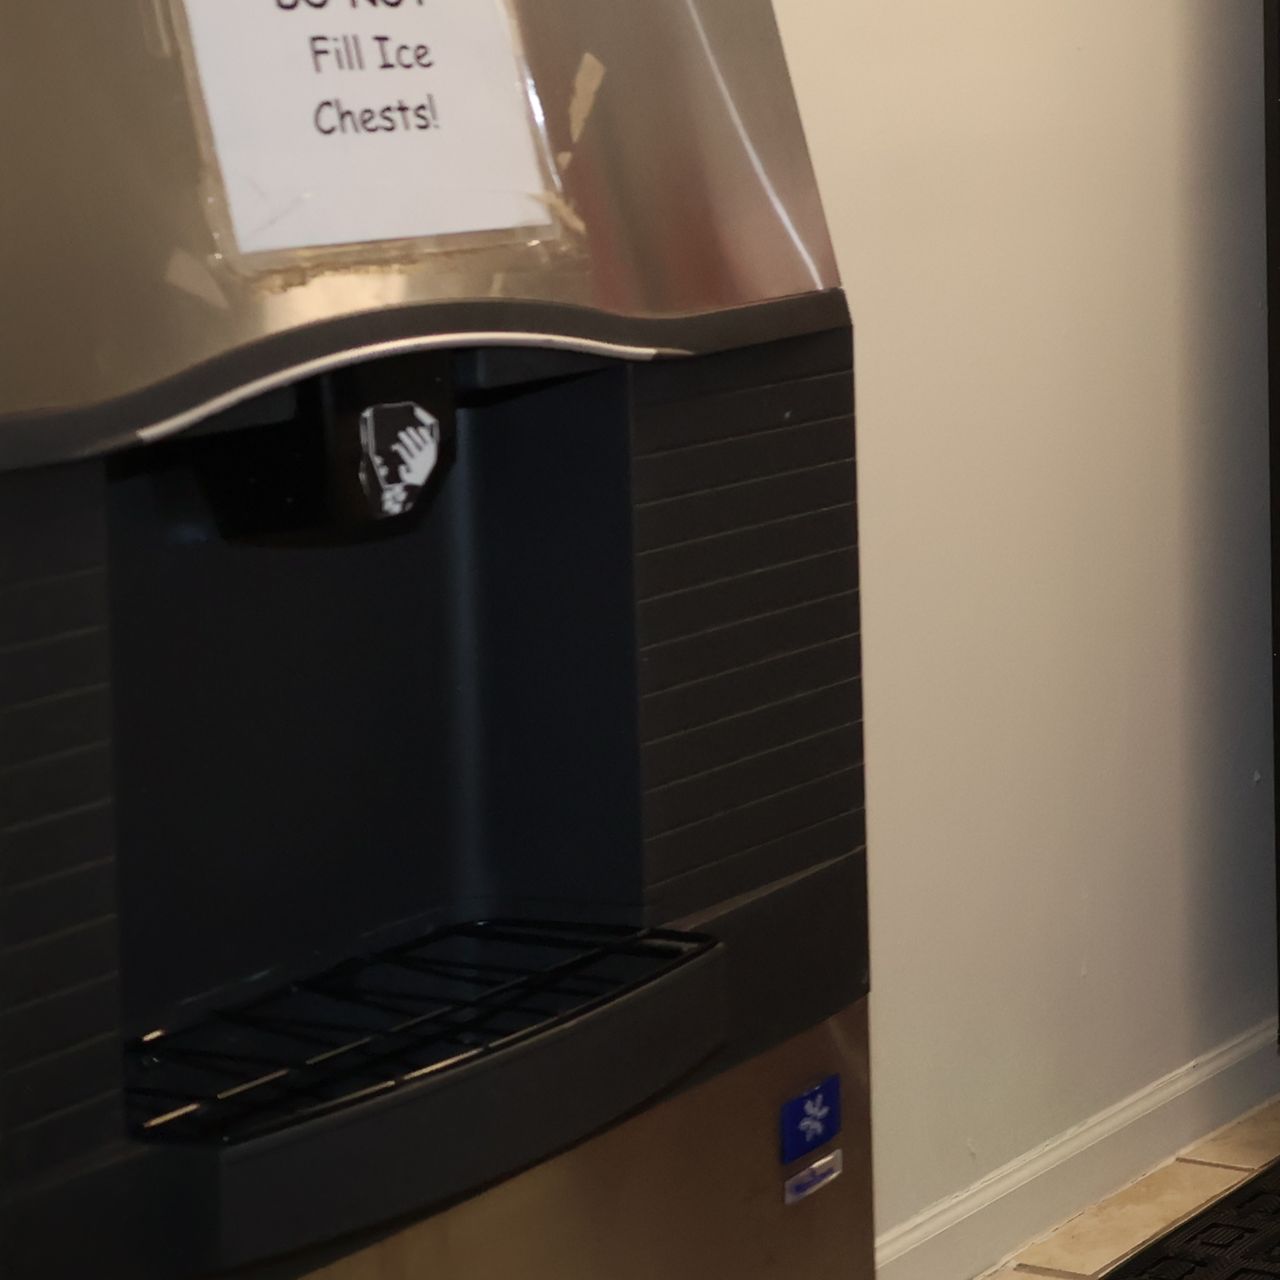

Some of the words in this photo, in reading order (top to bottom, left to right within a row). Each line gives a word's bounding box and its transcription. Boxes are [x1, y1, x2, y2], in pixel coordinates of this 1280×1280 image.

[309, 36, 364, 73] Fill
[374, 36, 433, 70] Ice
[314, 94, 440, 136] Chests!
